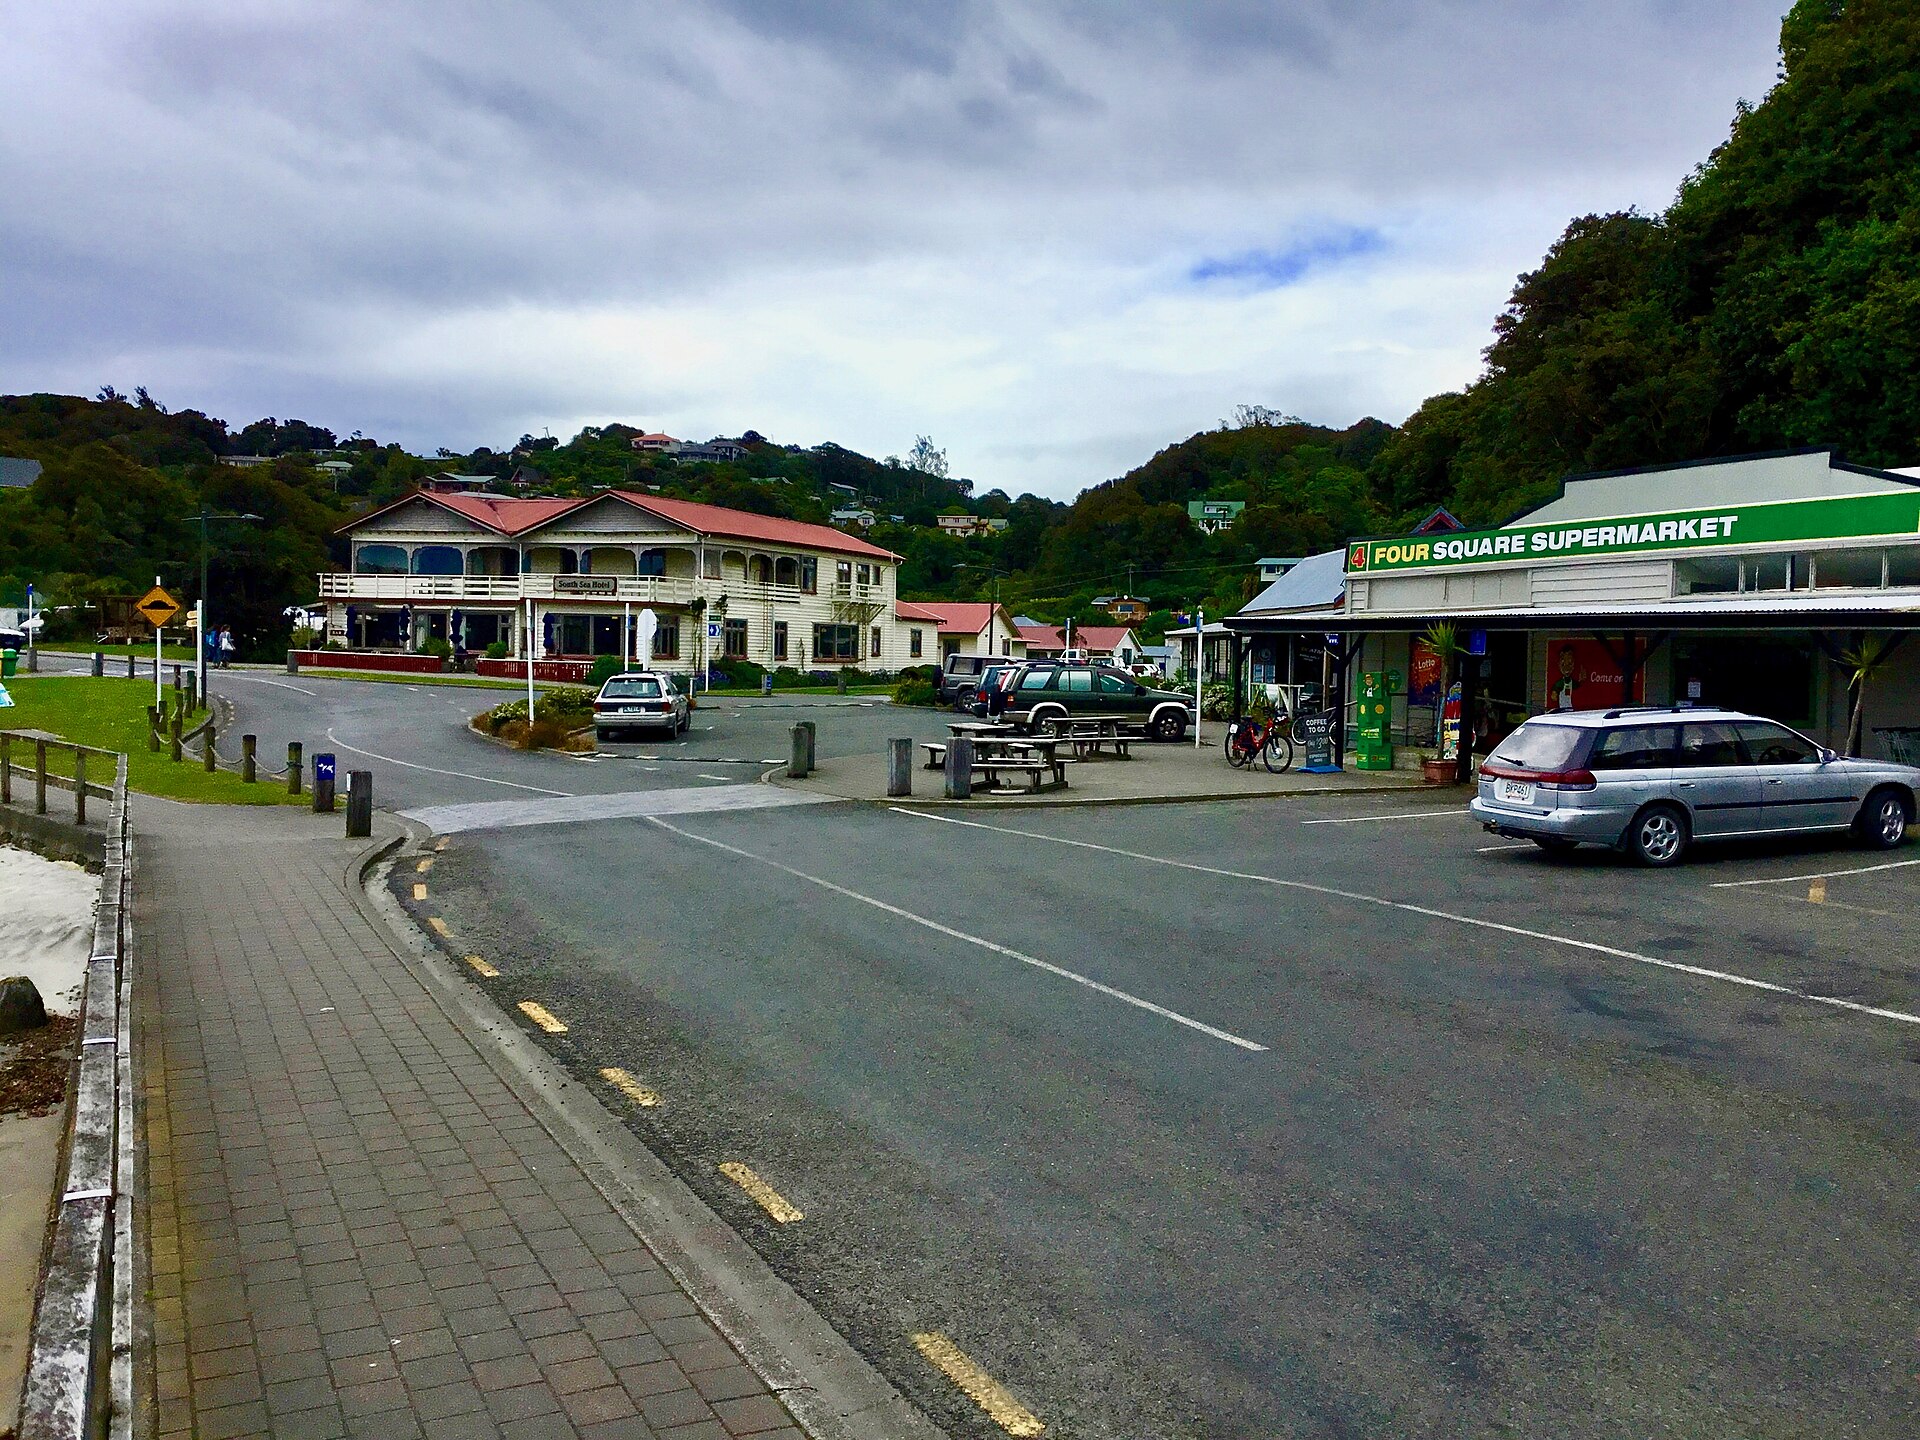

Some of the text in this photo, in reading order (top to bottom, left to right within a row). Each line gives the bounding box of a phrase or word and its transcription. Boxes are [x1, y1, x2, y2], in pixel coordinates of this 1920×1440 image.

[1351, 516, 1738, 567] 4 FOUR SQUARE SUPERMARKET
[558, 580, 578, 588] South
[592, 580, 610, 588] Hotel
[1418, 658, 1436, 669] Lotto
[1590, 671, 1612, 683] Come
[1306, 719, 1327, 727] COFFEE
